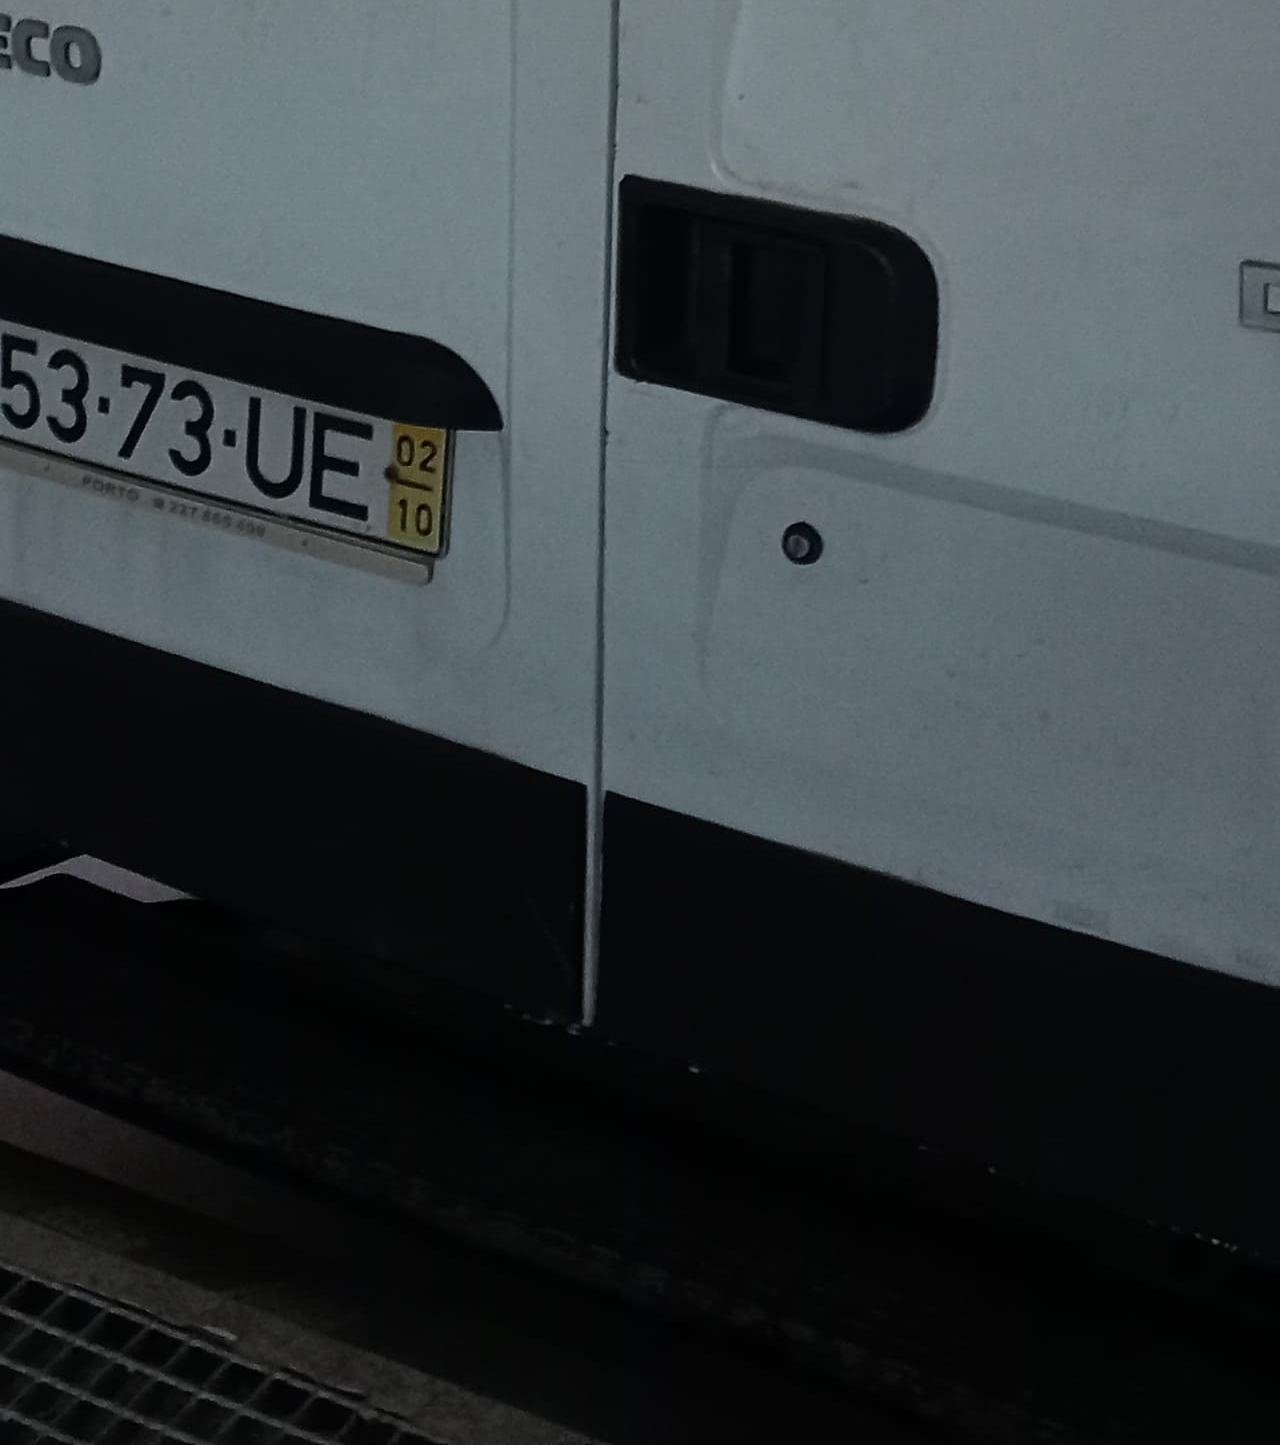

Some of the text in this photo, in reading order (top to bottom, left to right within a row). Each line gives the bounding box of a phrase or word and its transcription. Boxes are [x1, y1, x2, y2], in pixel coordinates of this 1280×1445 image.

[395, 434, 438, 474] 02
[82, 475, 140, 503] PORTO
[396, 499, 434, 538] 10
